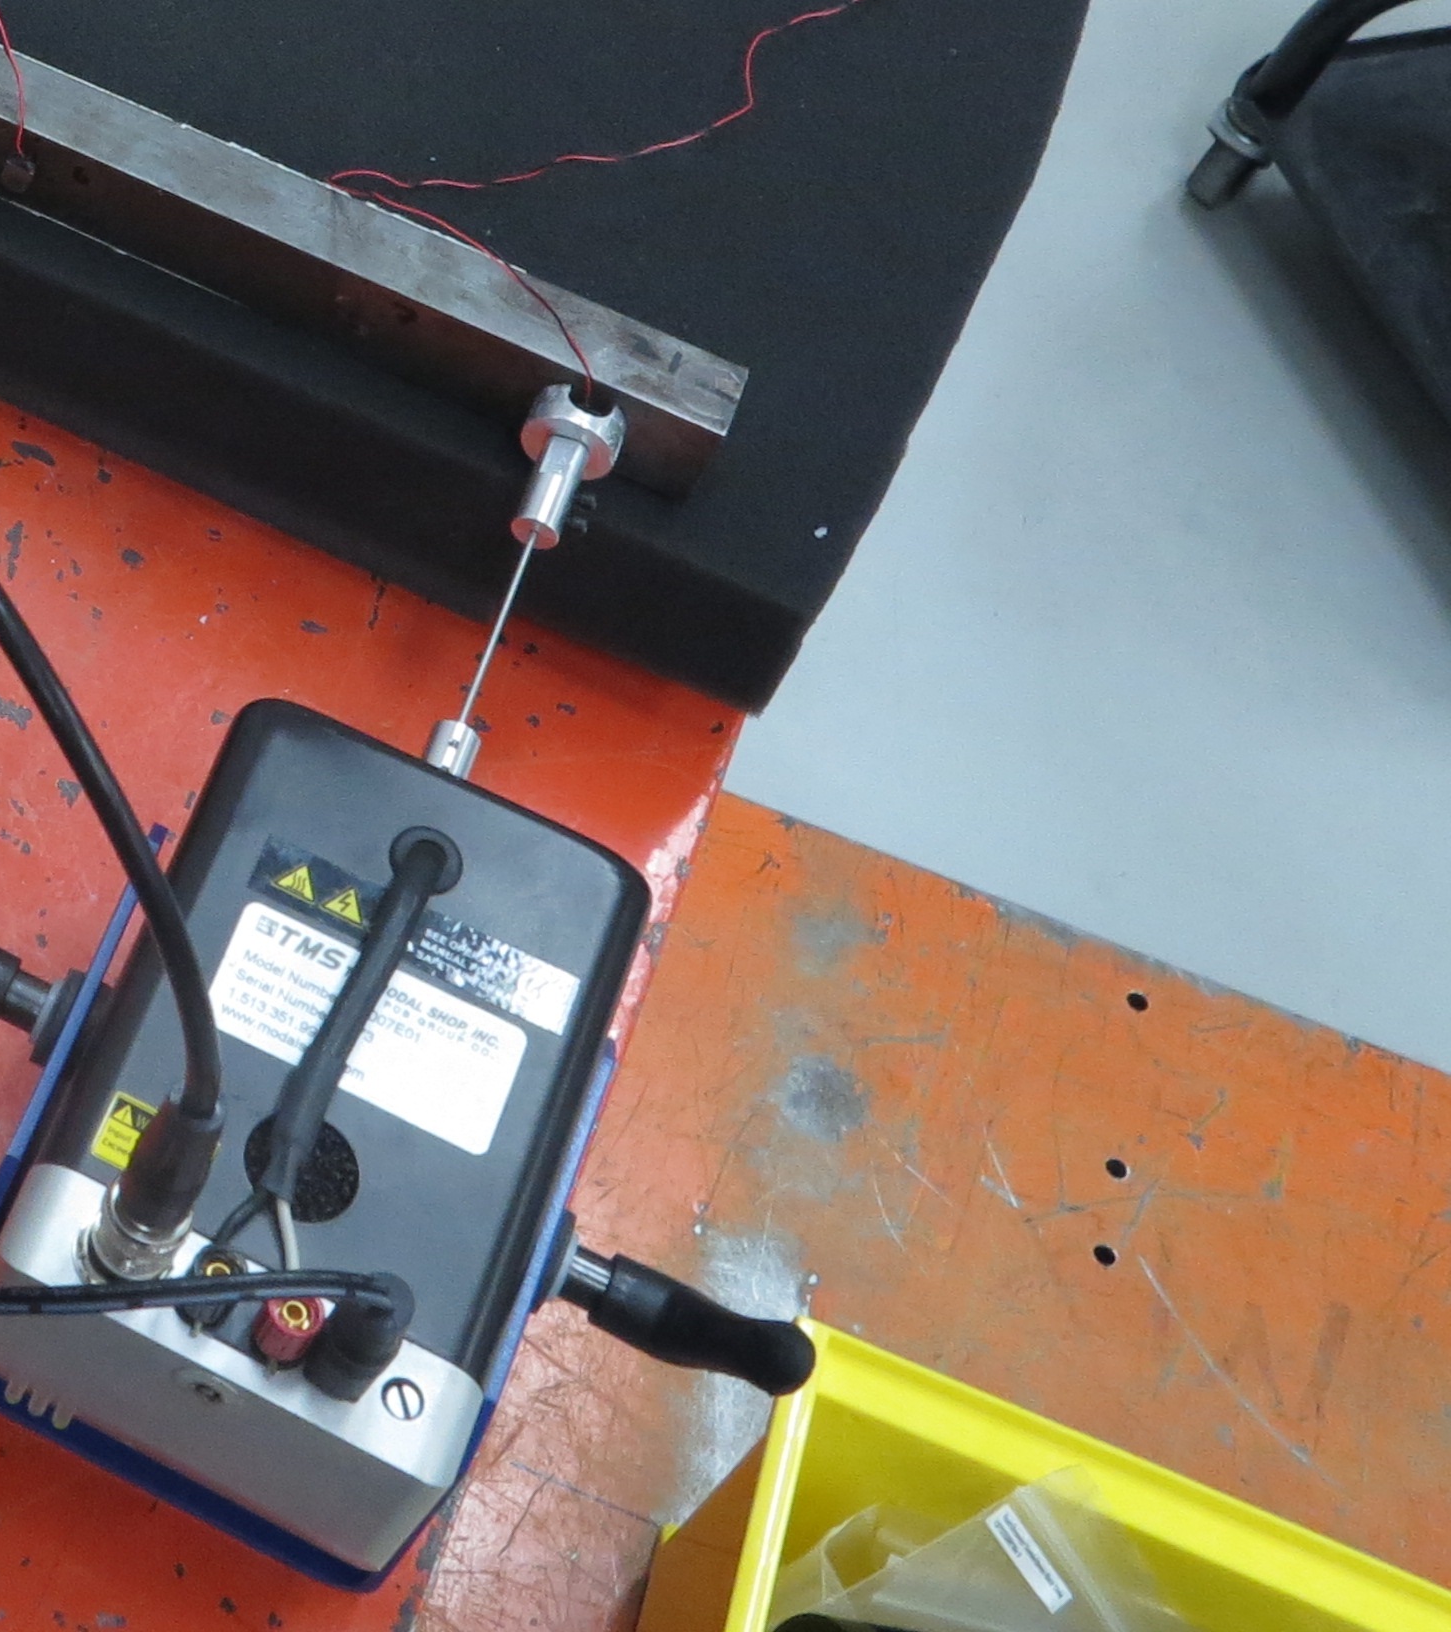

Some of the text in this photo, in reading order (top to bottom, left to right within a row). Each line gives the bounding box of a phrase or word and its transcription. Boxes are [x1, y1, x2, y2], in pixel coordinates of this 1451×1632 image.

[233, 966, 276, 996] Serial
[275, 986, 329, 1022] Numbe
[241, 948, 423, 1045] Model Numbe 007E01
[274, 923, 503, 1051] TMS ODAL SHOP, INC.
